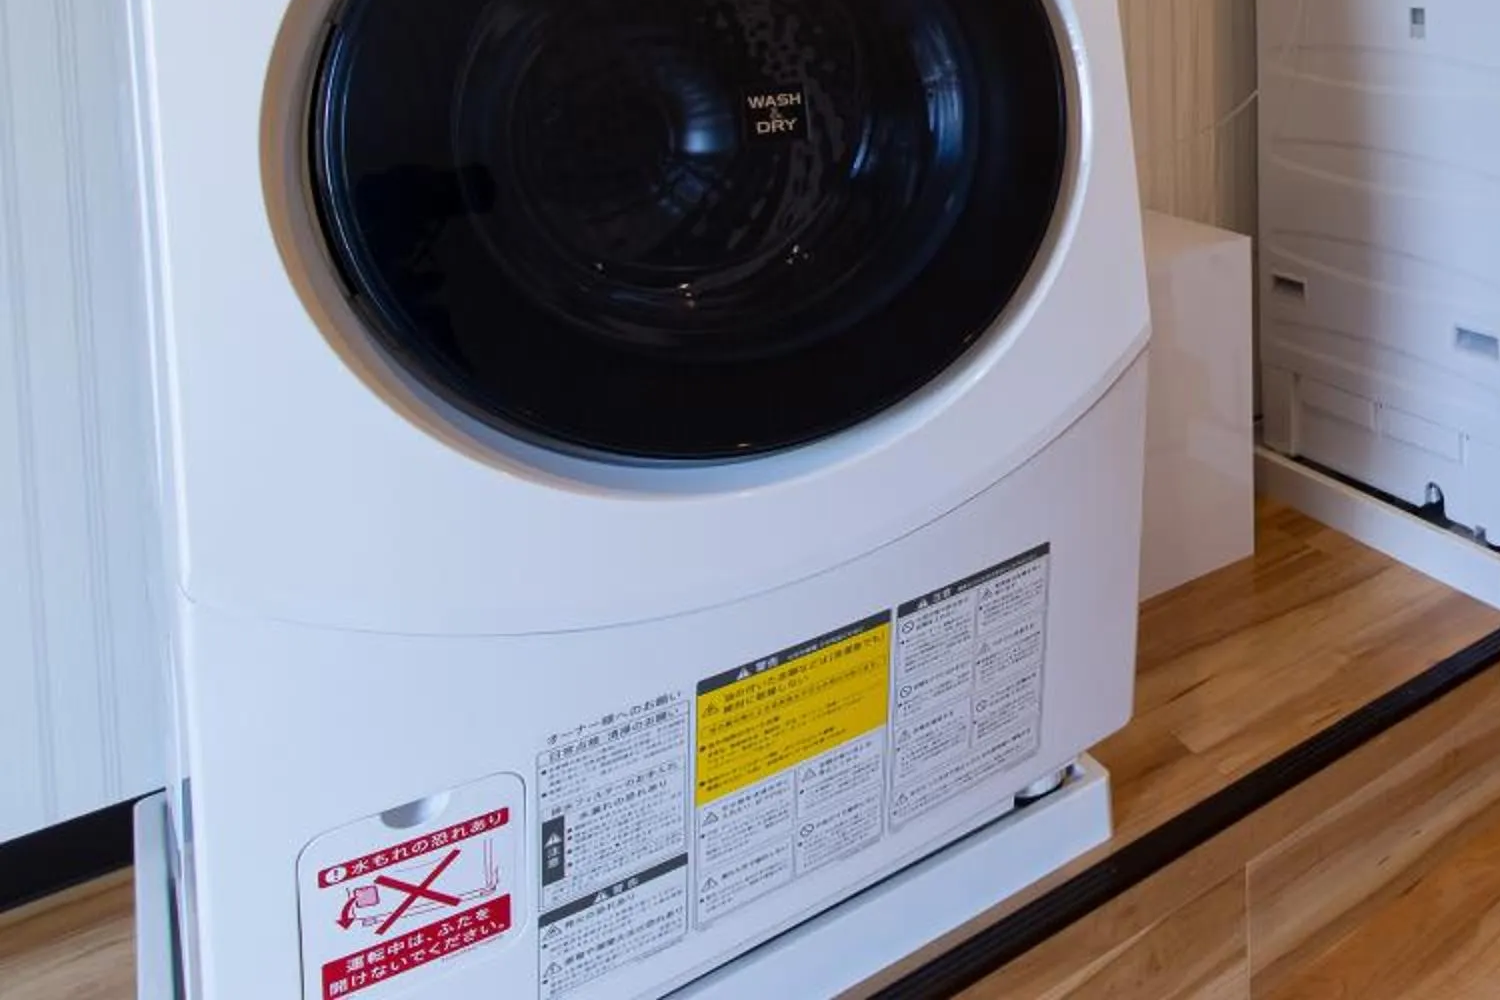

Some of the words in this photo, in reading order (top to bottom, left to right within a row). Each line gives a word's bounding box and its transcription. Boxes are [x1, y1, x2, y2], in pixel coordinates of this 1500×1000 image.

[747, 92, 801, 109] WASH
[756, 117, 798, 135] DRY
[546, 690, 681, 746] オーナー様へのお願い
[351, 812, 501, 876] 水もれの恐れあり
[328, 921, 505, 997] 開けないでください。
[346, 906, 491, 974] 運転中は、ふたを
